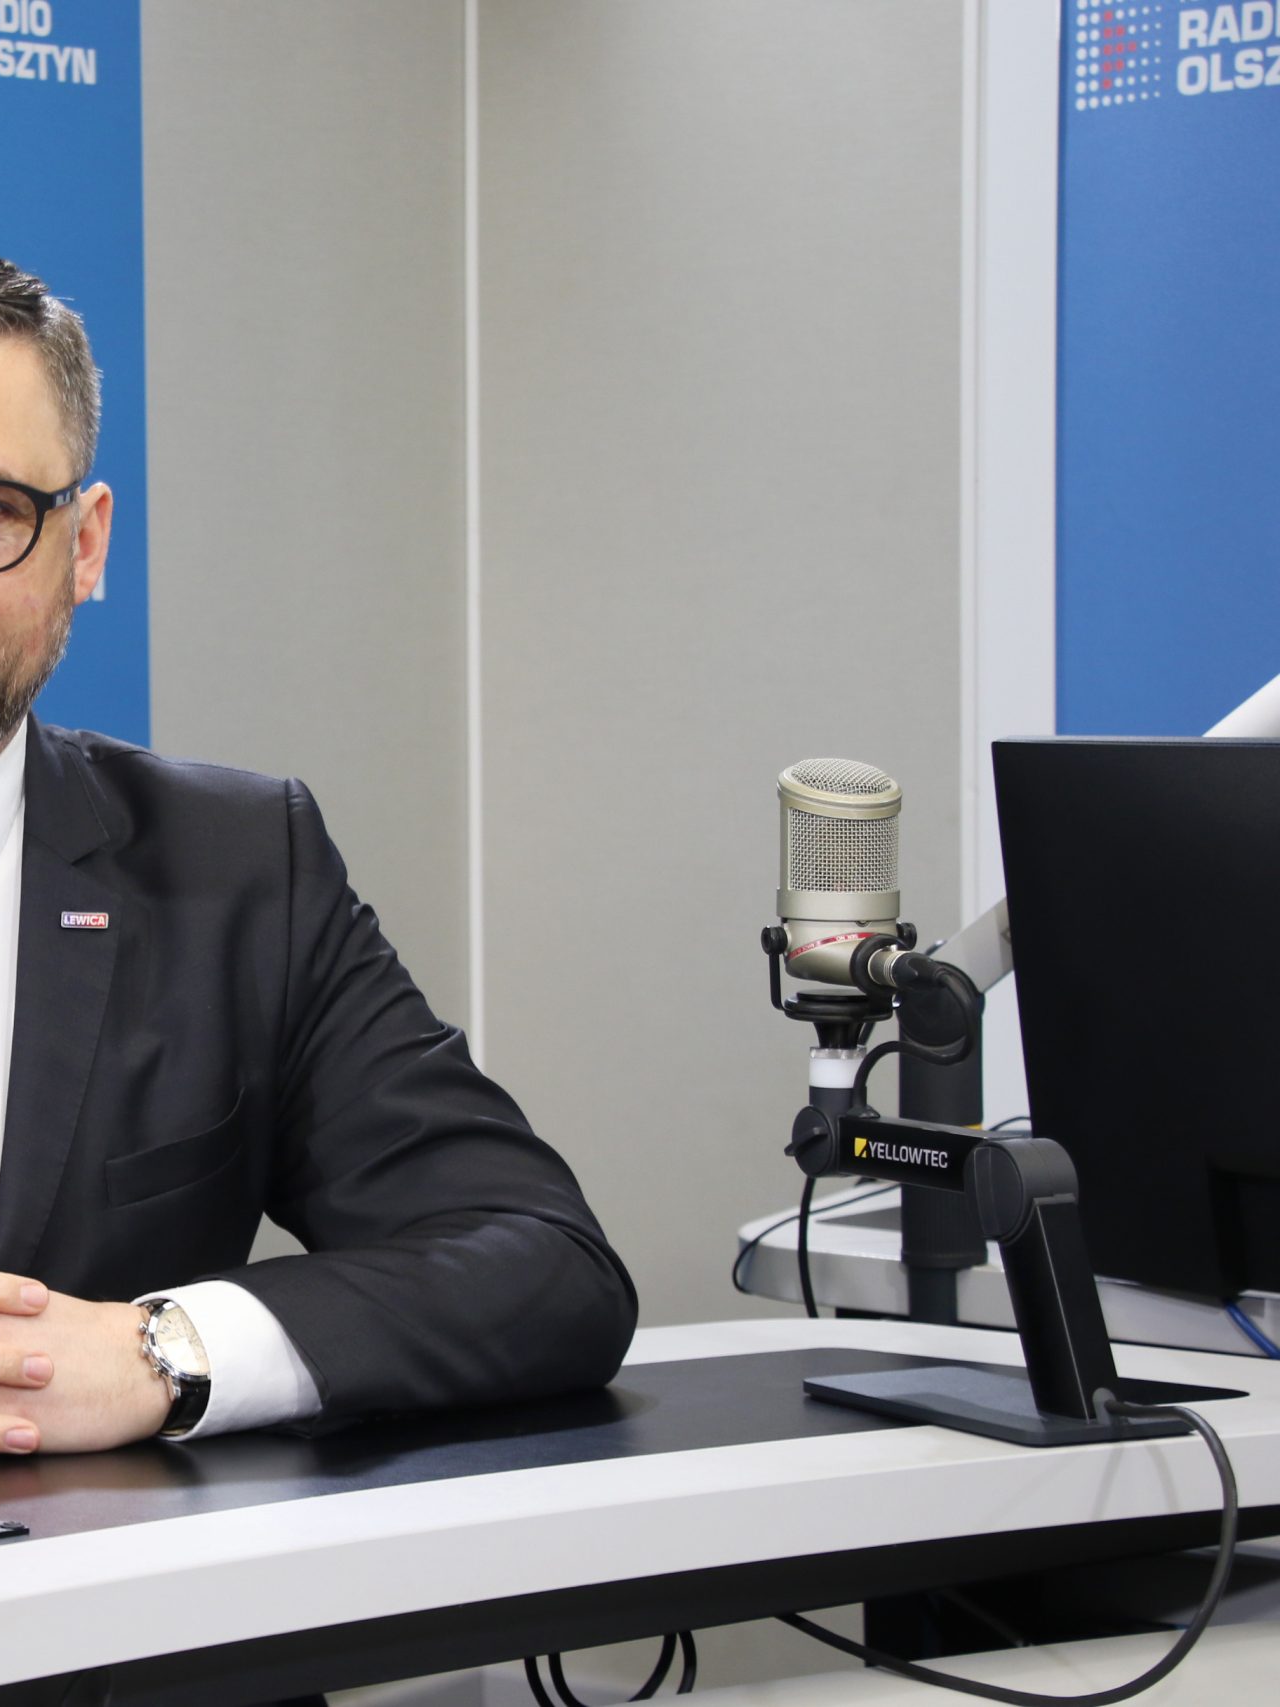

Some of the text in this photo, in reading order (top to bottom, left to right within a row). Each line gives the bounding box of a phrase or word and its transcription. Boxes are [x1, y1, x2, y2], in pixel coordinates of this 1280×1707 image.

[1178, 0, 1280, 50] RAD
[63, 914, 106, 926] LEWICA
[868, 1141, 948, 1168] YELLOWTEC
